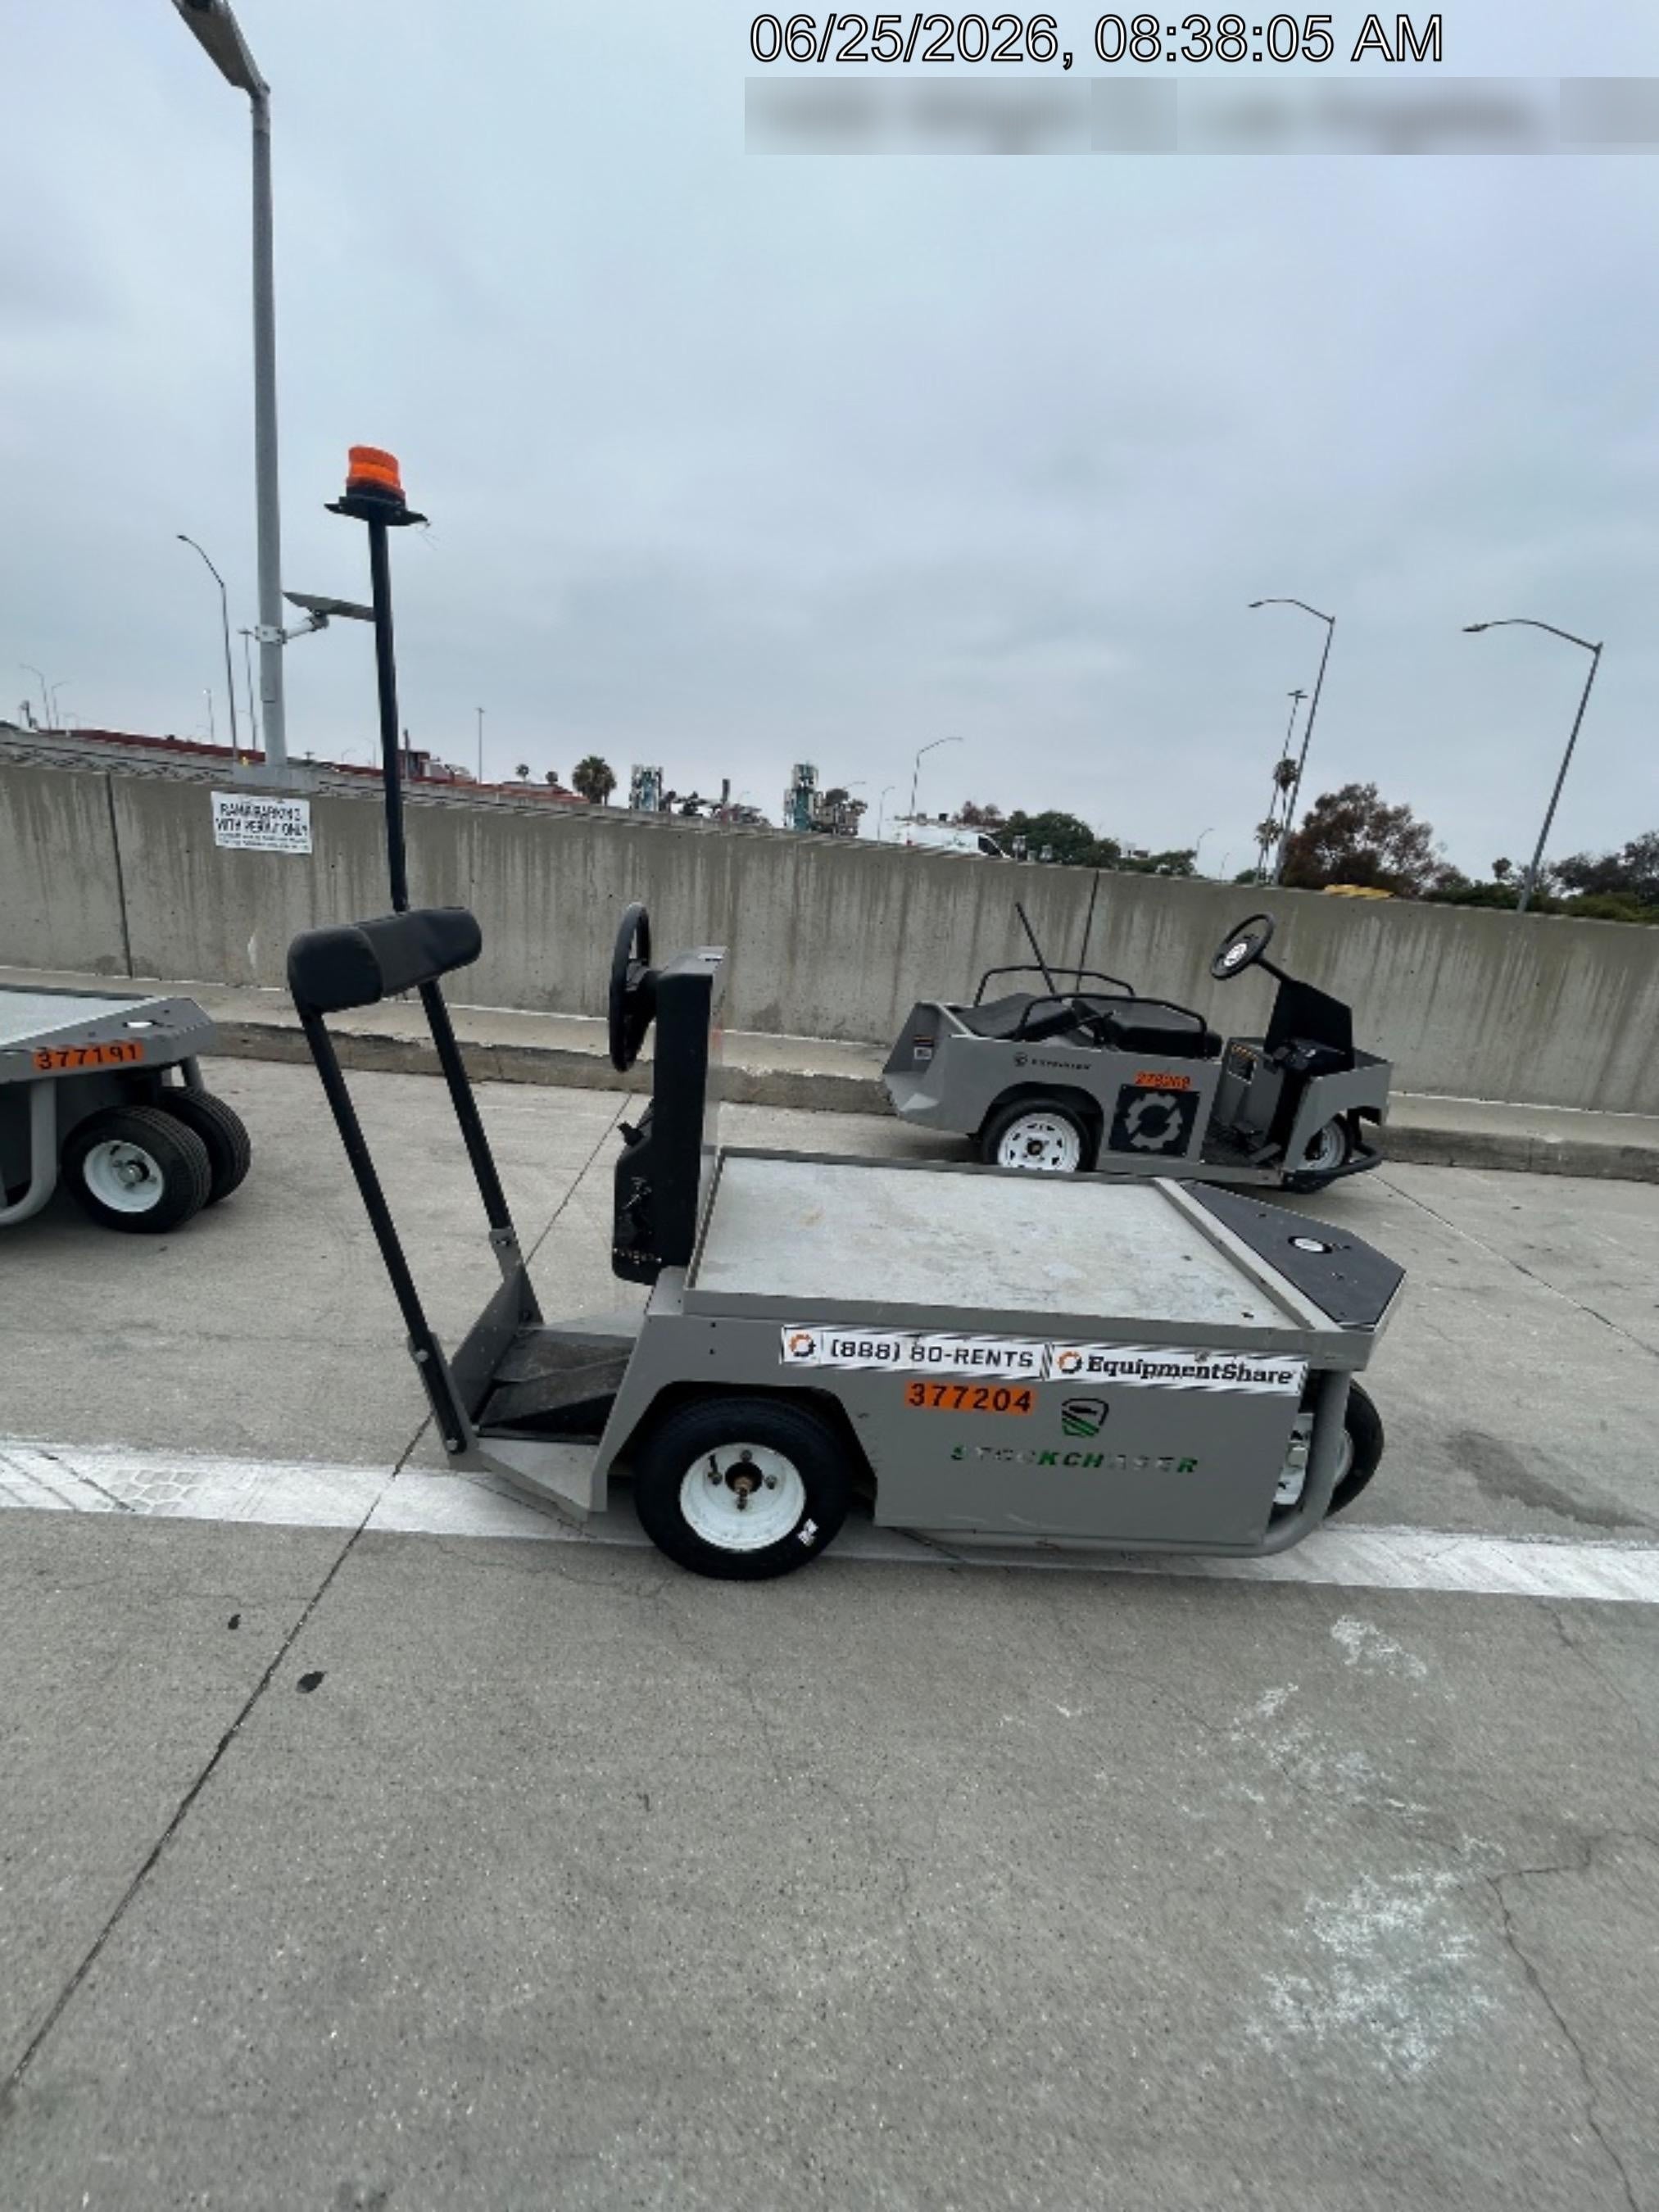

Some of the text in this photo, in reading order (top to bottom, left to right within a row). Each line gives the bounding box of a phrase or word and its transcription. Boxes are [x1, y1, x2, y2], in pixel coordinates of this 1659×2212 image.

[36, 1044, 137, 1071] 377191
[831, 1339, 1034, 1367] (888) 80-RENTS
[1086, 1353, 1294, 1385] EquipmentShare
[908, 1382, 1032, 1412] 377204
